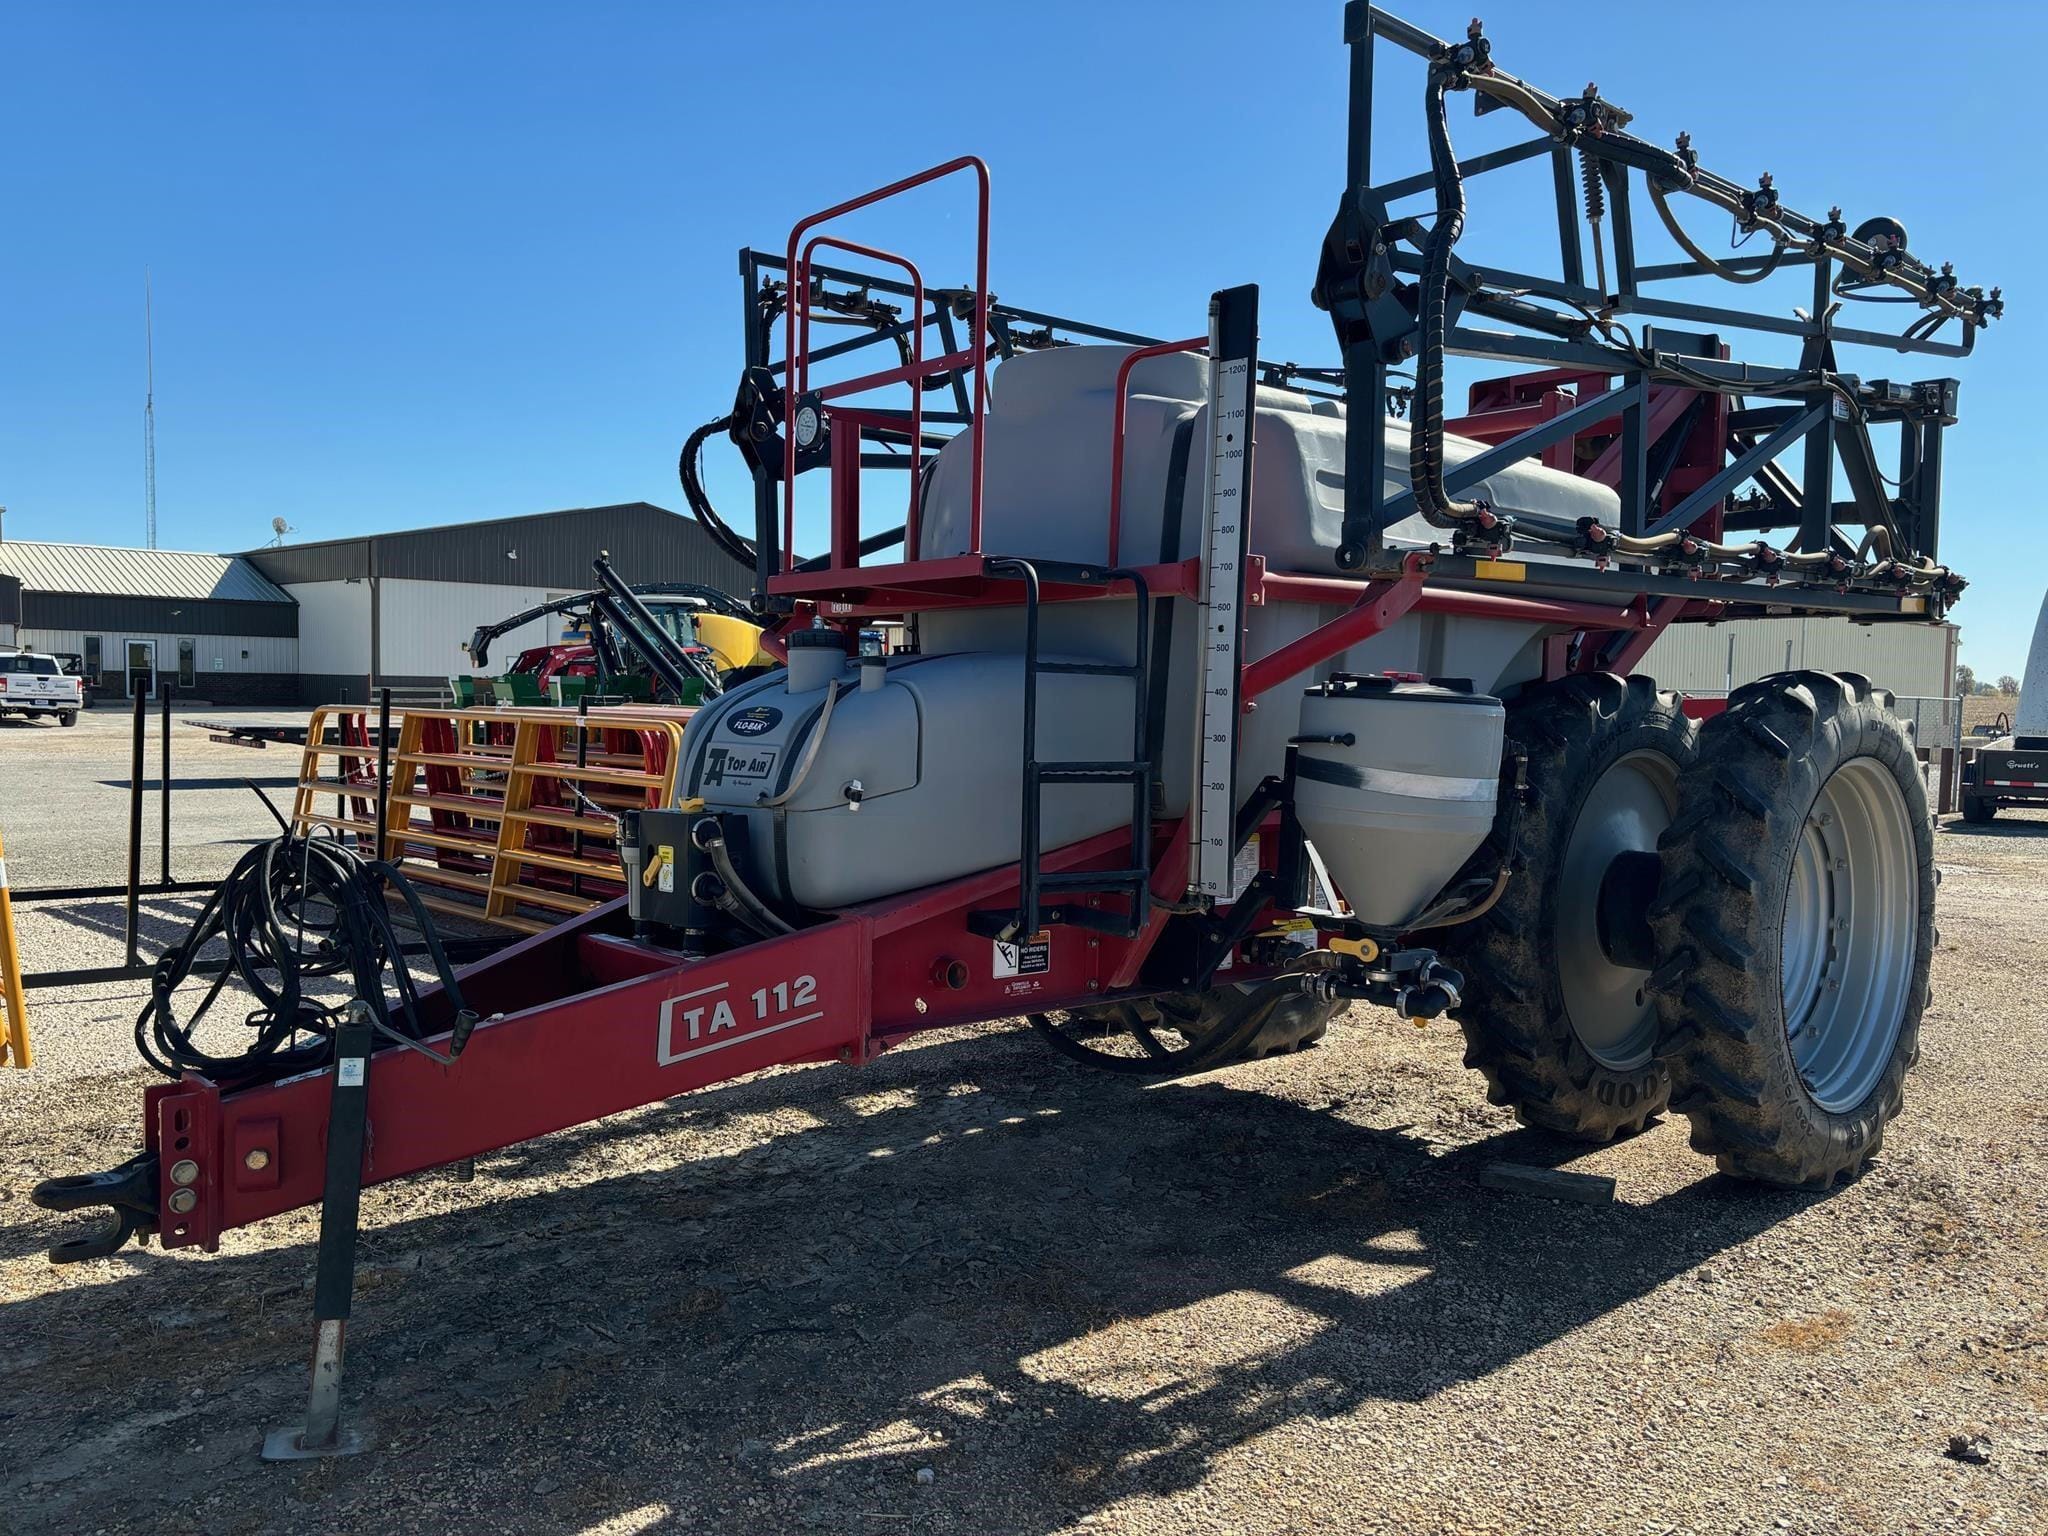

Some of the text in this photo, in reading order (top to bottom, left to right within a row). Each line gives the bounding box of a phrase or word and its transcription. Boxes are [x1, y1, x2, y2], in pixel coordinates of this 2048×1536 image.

[1229, 364, 1247, 374] 1200
[1227, 409, 1245, 419] 1100
[1225, 449, 1243, 458] 1000
[1223, 488, 1237, 497] 900
[1221, 525, 1235, 534] 800
[1219, 562, 1233, 571] 700
[1217, 603, 1231, 611] 600
[1216, 643, 1229, 652] 500
[1214, 687, 1228, 696] 400
[1213, 734, 1227, 743] 300
[728, 756, 767, 772] TOP AIR
[1211, 782, 1225, 791] 200
[1210, 838, 1223, 847] 100
[1208, 881, 1217, 890] 50
[683, 975, 817, 1040] TA 112
